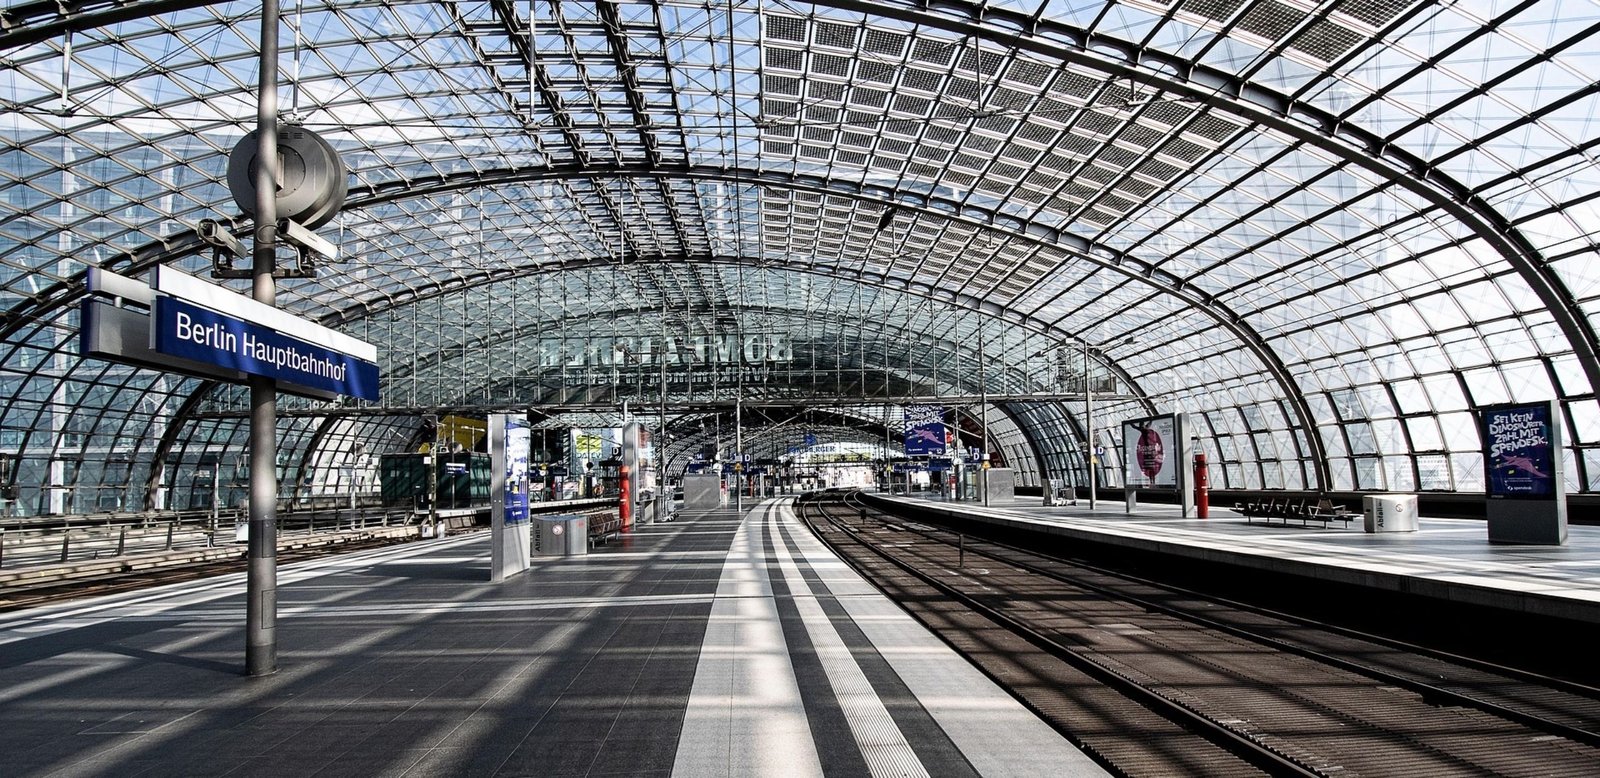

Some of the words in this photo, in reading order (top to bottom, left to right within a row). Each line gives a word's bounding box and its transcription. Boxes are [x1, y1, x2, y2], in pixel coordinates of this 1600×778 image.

[176, 311, 237, 353] Berlin
[243, 332, 346, 382] Hauptbahnhof
[1493, 415, 1509, 424] SEI
[1510, 413, 1533, 423] KEIN
[1495, 432, 1519, 443] ZAHL
[1520, 428, 1540, 439] MIT
[612, 447, 619, 455] D
[1097, 446, 1103, 454] D
[744, 453, 751, 461] D
[1377, 507, 1385, 528] Abfall
